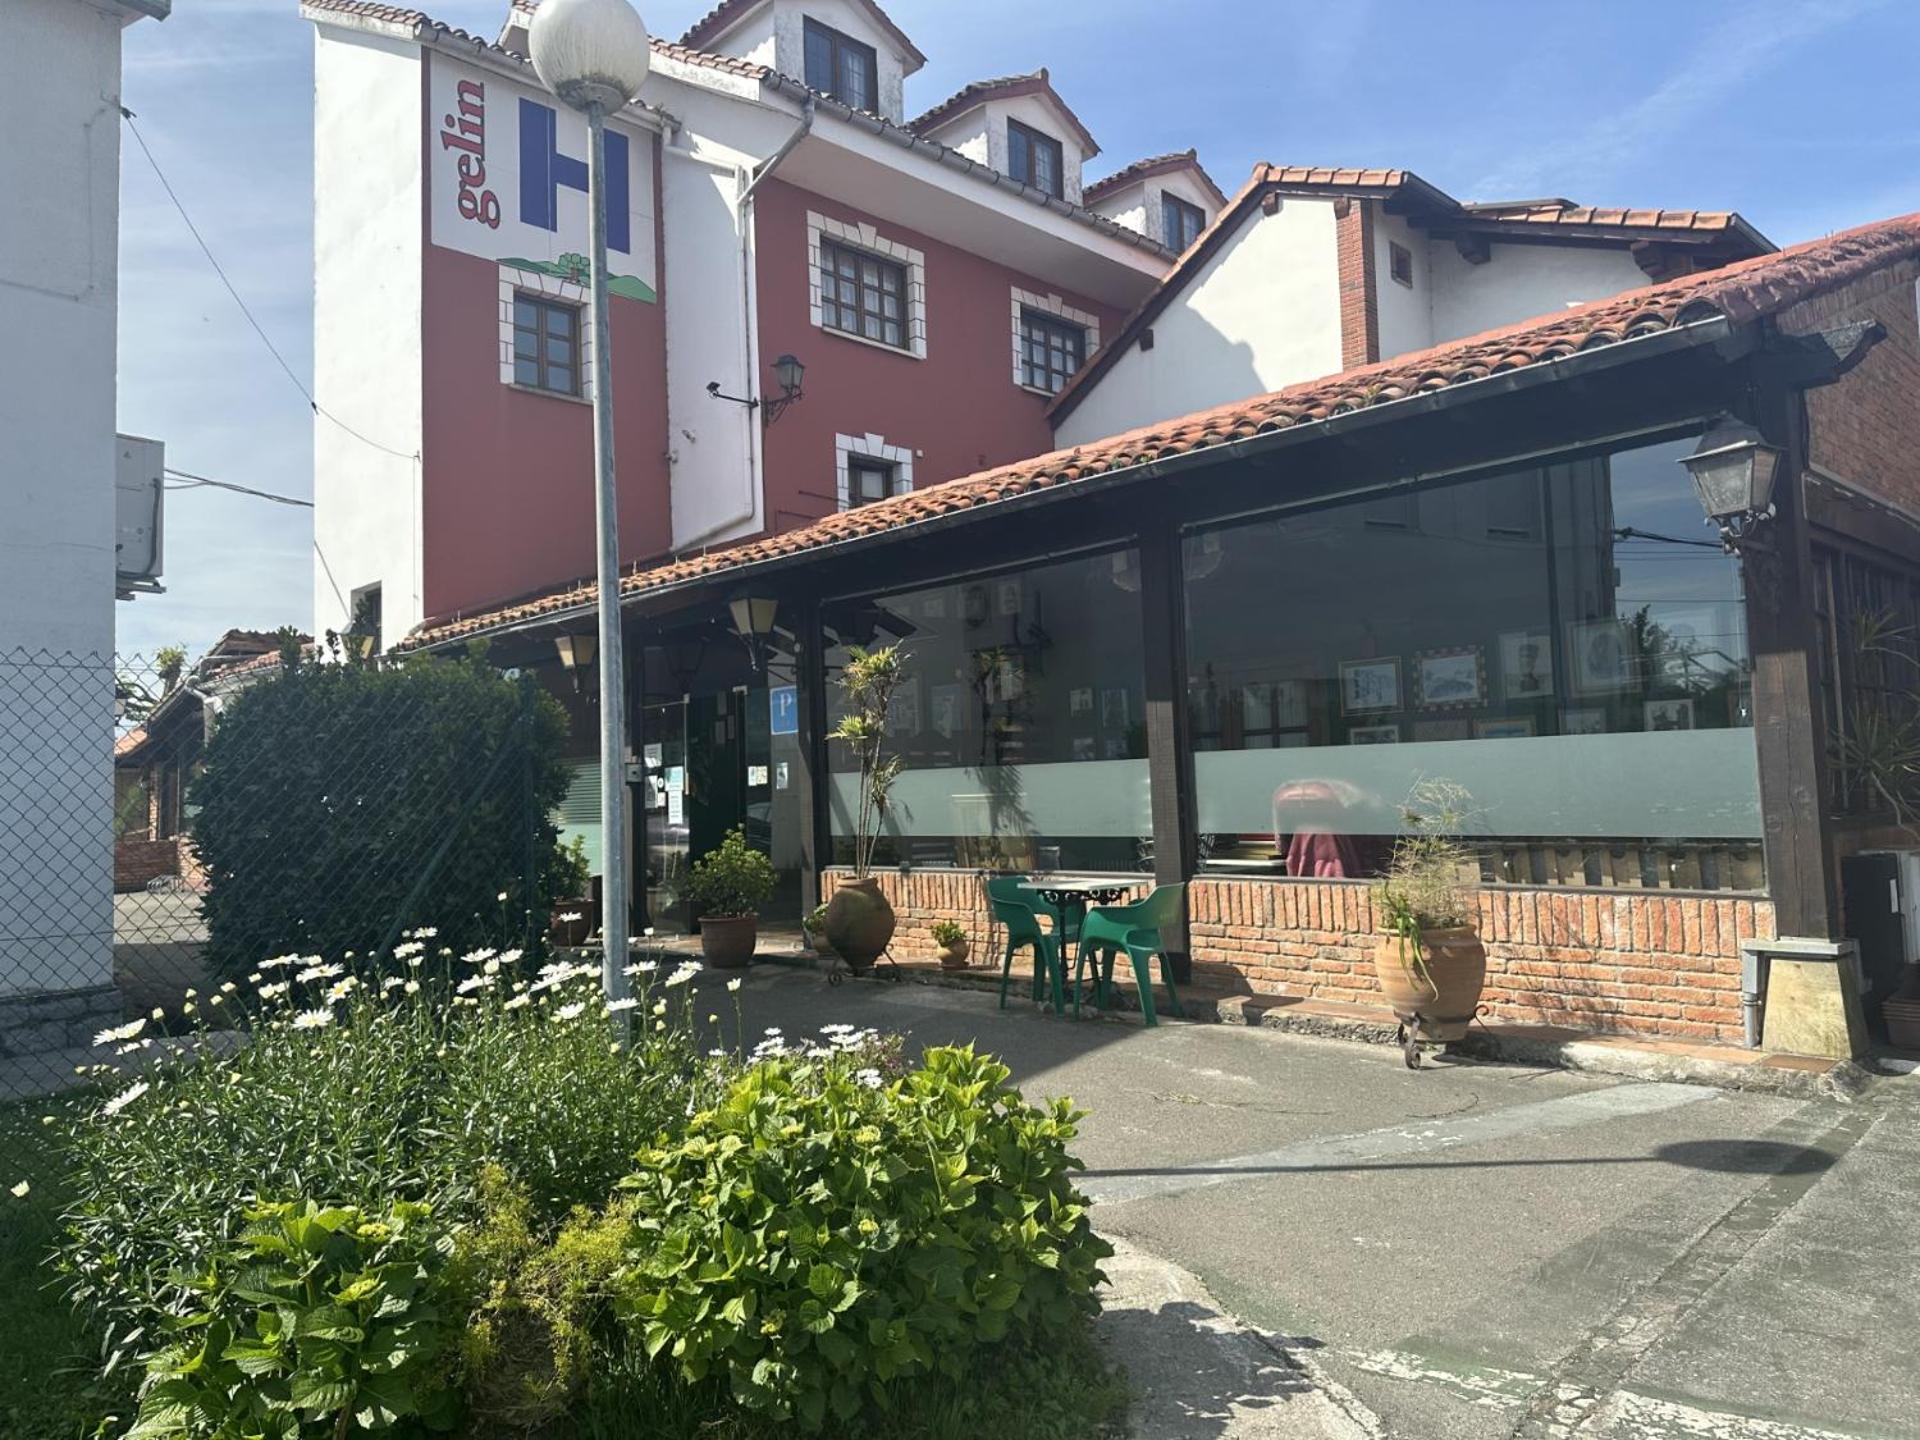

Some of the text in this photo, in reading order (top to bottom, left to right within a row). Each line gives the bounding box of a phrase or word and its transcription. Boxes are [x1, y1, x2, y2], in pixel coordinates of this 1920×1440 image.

[440, 79, 500, 229] gelin
[519, 96, 630, 255] H
[780, 693, 792, 717] P
